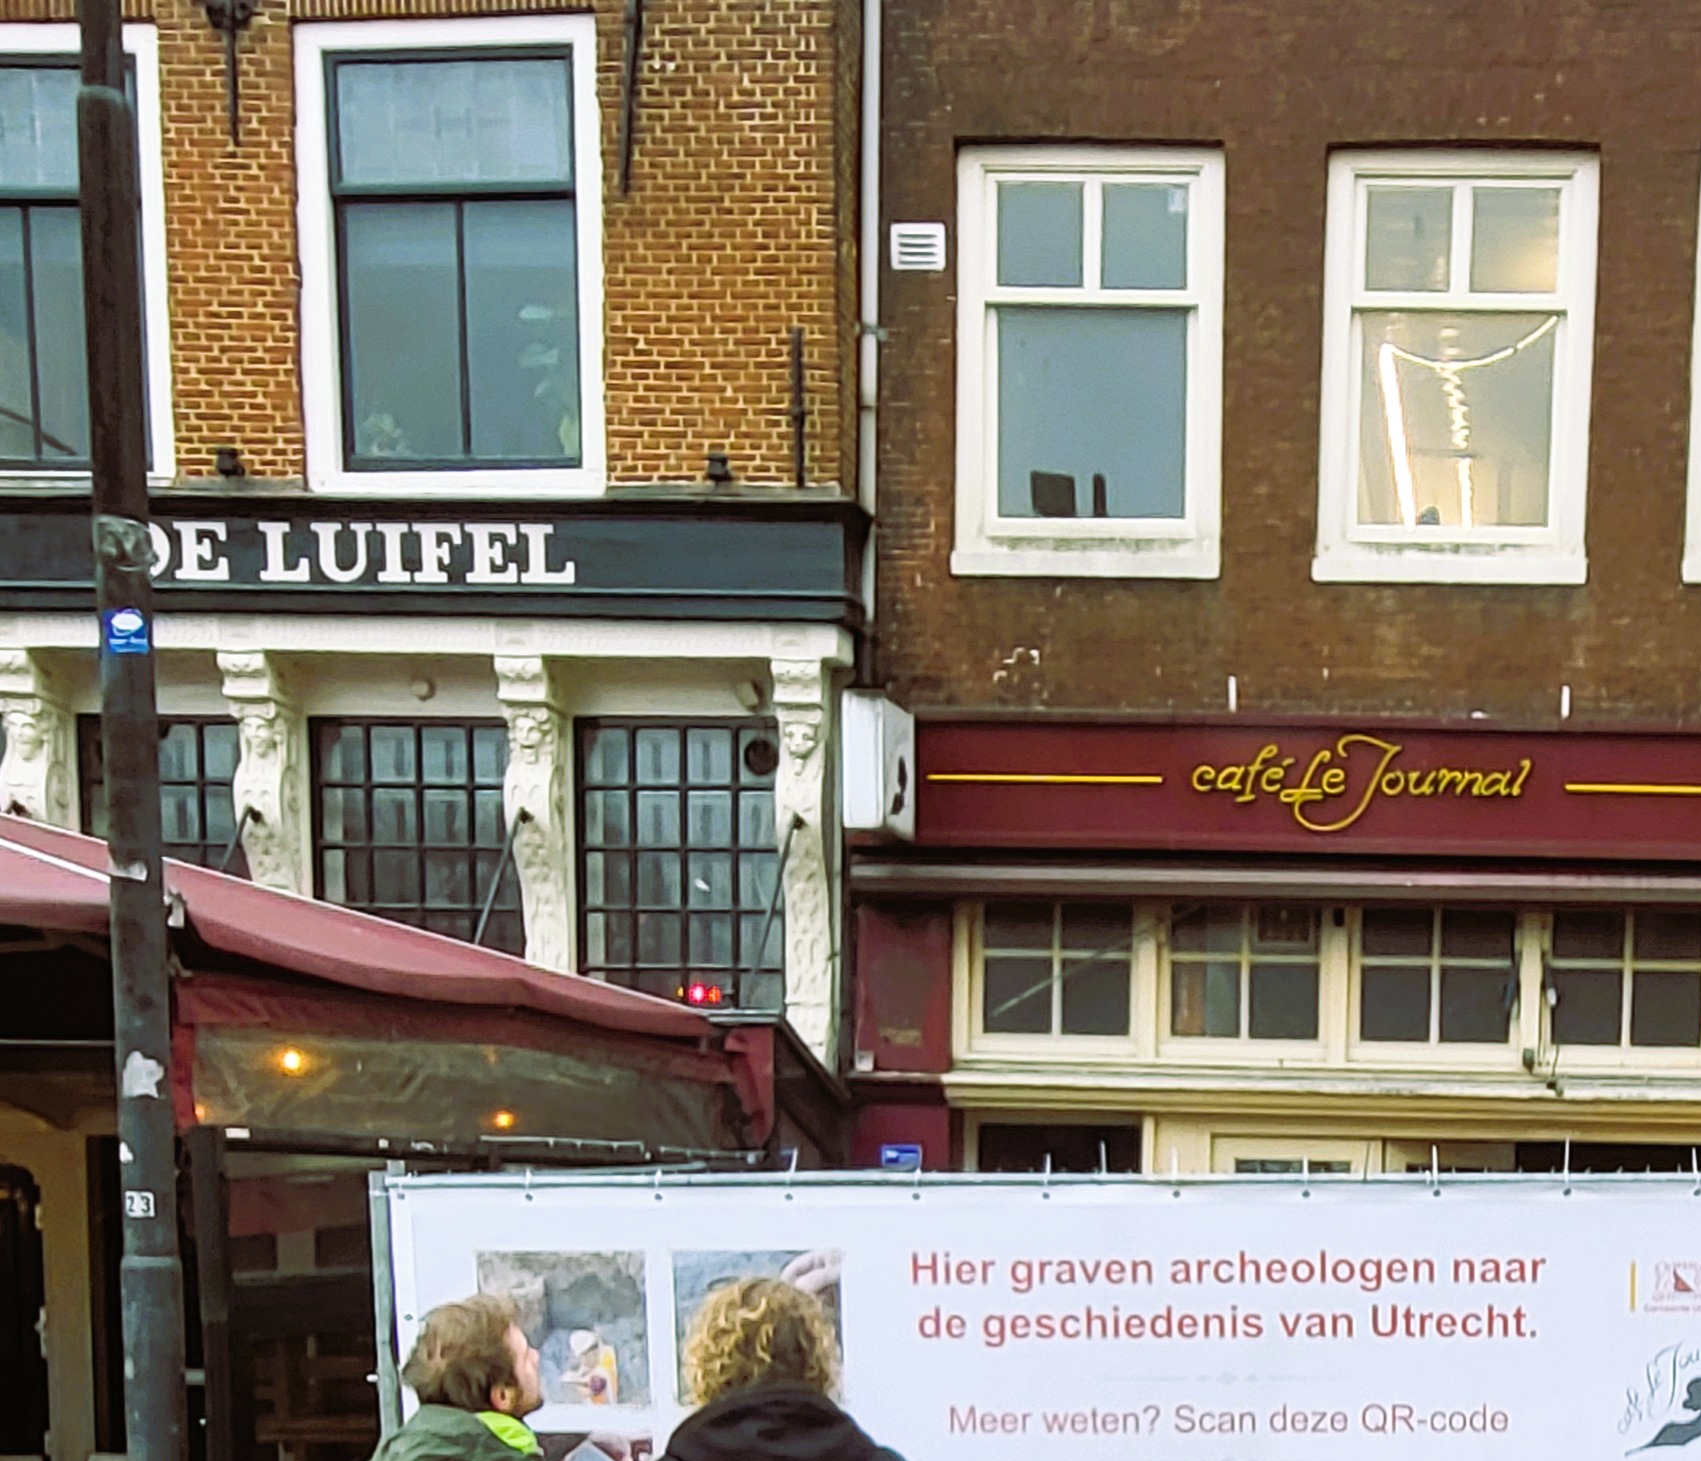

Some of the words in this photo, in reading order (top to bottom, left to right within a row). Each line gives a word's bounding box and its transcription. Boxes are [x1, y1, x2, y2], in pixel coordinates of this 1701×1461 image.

[257, 520, 577, 585] LUIFEL
[1190, 743, 1295, 803] café
[1279, 748, 1346, 803] Le
[1295, 733, 1533, 832] Journal
[127, 1195, 152, 1214] 23
[910, 1251, 996, 1286] Hier
[1010, 1258, 1153, 1294] graven
[1170, 1248, 1436, 1293] archeologen
[1452, 1256, 1547, 1285] naar
[917, 1305, 967, 1340] de
[982, 1304, 1265, 1348] geschiedenis
[1278, 1312, 1355, 1339] van
[1370, 1303, 1538, 1339] Utrecht.
[948, 1404, 1032, 1434] Meer
[1042, 1404, 1161, 1434] weten?
[1173, 1403, 1257, 1434] Scan
[1269, 1402, 1349, 1434] deze
[1361, 1402, 1510, 1435] QR-code
